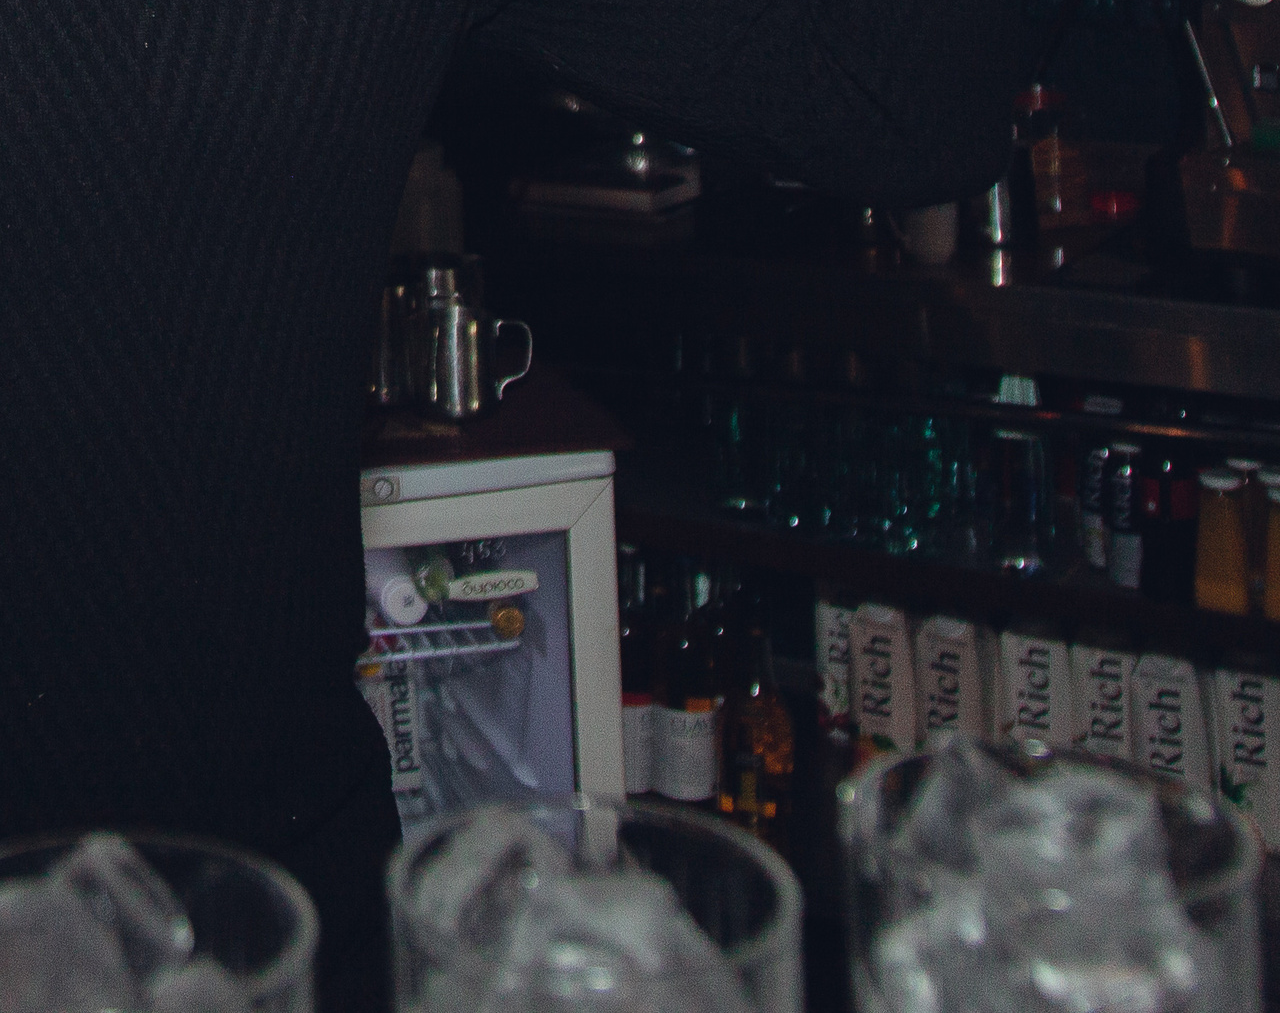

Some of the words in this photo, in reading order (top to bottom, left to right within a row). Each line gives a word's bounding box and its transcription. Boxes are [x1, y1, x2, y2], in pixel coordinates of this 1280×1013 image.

[863, 636, 891, 717] Rich
[928, 650, 959, 730] Rich
[1018, 647, 1050, 729] Rich
[1090, 658, 1123, 740] Rich
[1149, 690, 1185, 775] Rich
[1232, 680, 1267, 767] Rich
